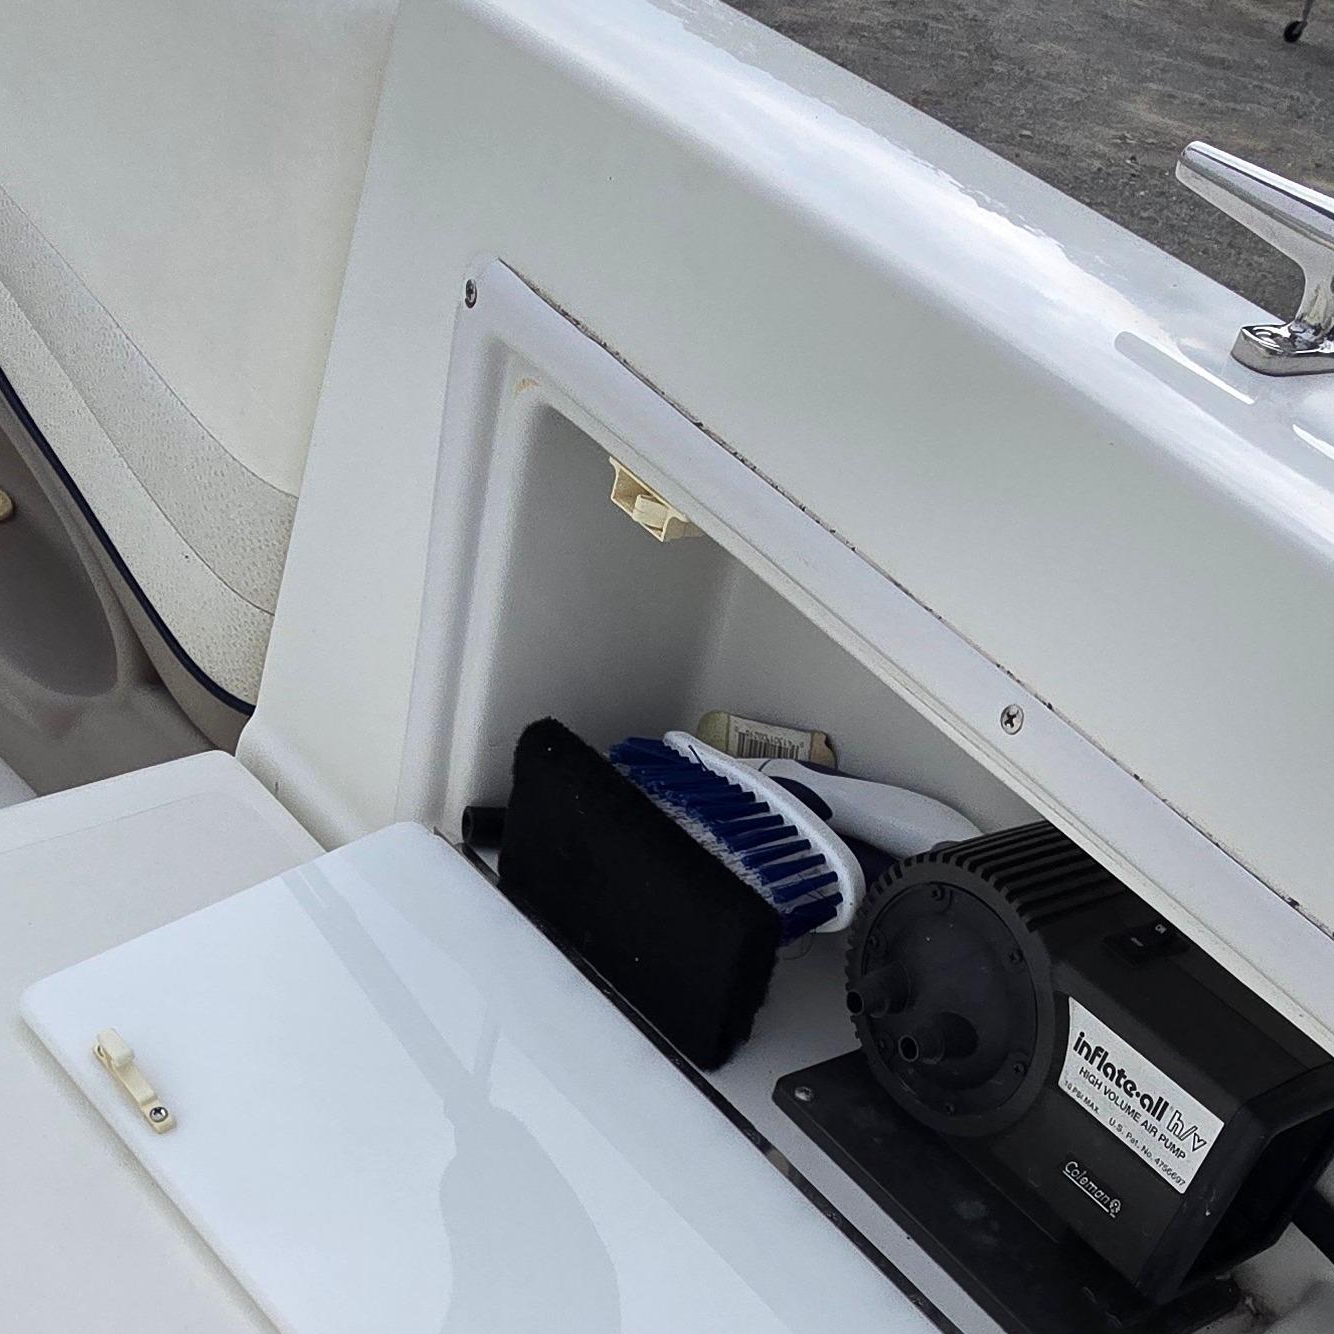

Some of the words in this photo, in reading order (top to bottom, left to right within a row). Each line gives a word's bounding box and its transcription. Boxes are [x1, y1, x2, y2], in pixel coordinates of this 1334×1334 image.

[1079, 1066, 1102, 1090] HIGH
[1103, 1085, 1142, 1122] VOLUME
[1141, 1120, 1158, 1137] AIR
[1158, 1134, 1186, 1159] PUMP
[1109, 1117, 1124, 1135] U.S.
[1125, 1131, 1140, 1149] Pat.
[1140, 1145, 1154, 1161] No.
[1065, 1161, 1110, 1204] Coleman
